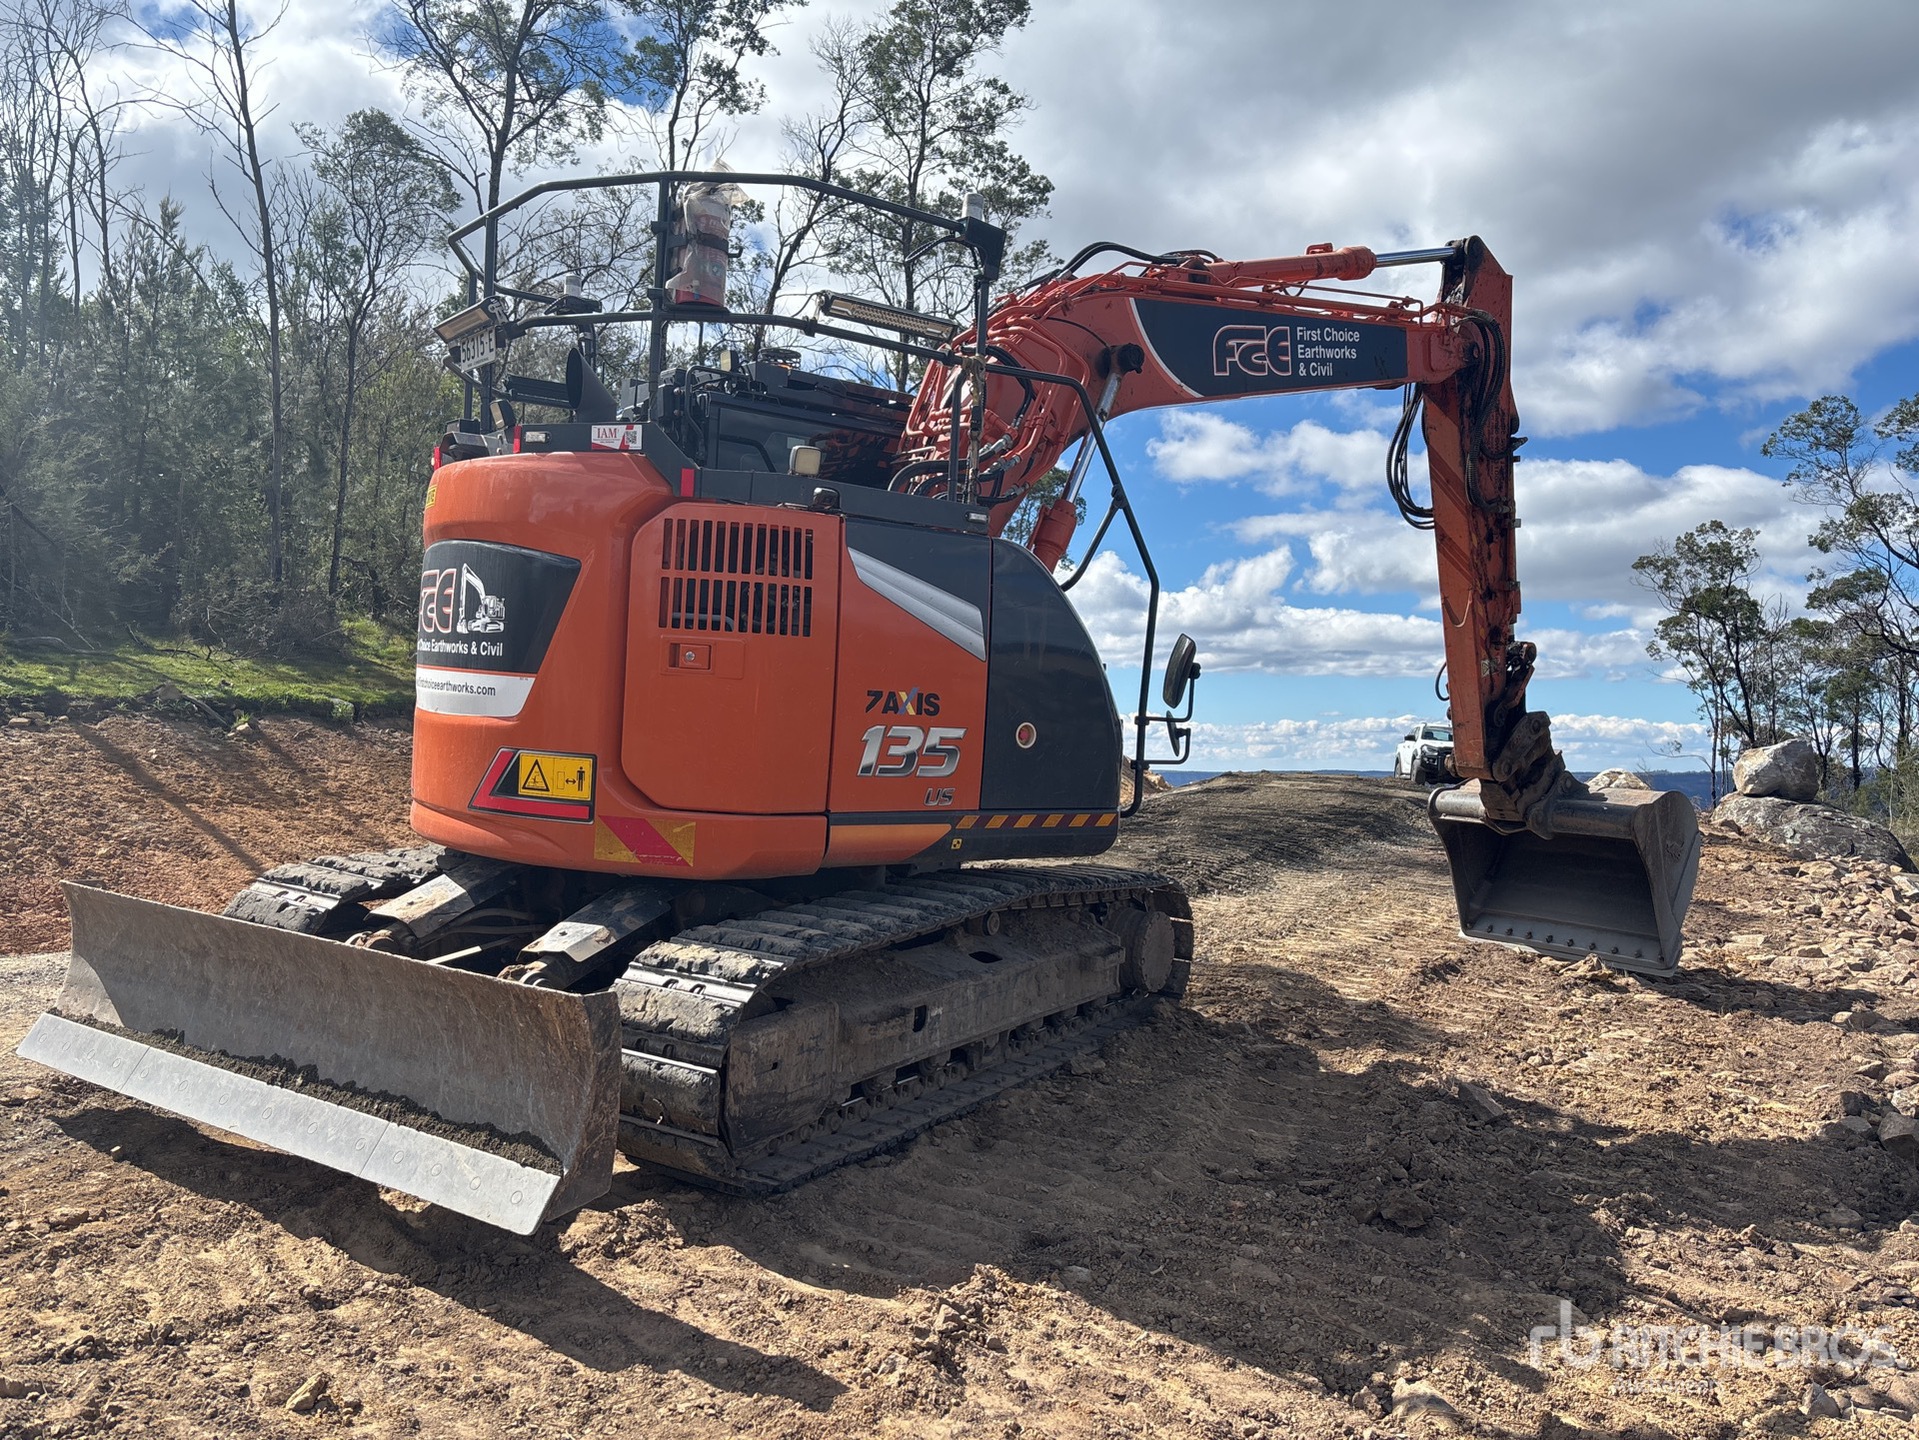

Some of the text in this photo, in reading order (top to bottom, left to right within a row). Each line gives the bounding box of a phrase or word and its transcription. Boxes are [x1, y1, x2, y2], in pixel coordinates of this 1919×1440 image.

[1296, 327, 1360, 342] First Choice
[1213, 324, 1292, 376] FCE
[1297, 344, 1357, 359] Earthworks
[1299, 363, 1333, 376] & Civil
[431, 639, 468, 654] Earthworks
[470, 641, 478, 655] &
[480, 641, 503, 657] Civil
[857, 725, 968, 778] 135
[923, 788, 955, 806] US
